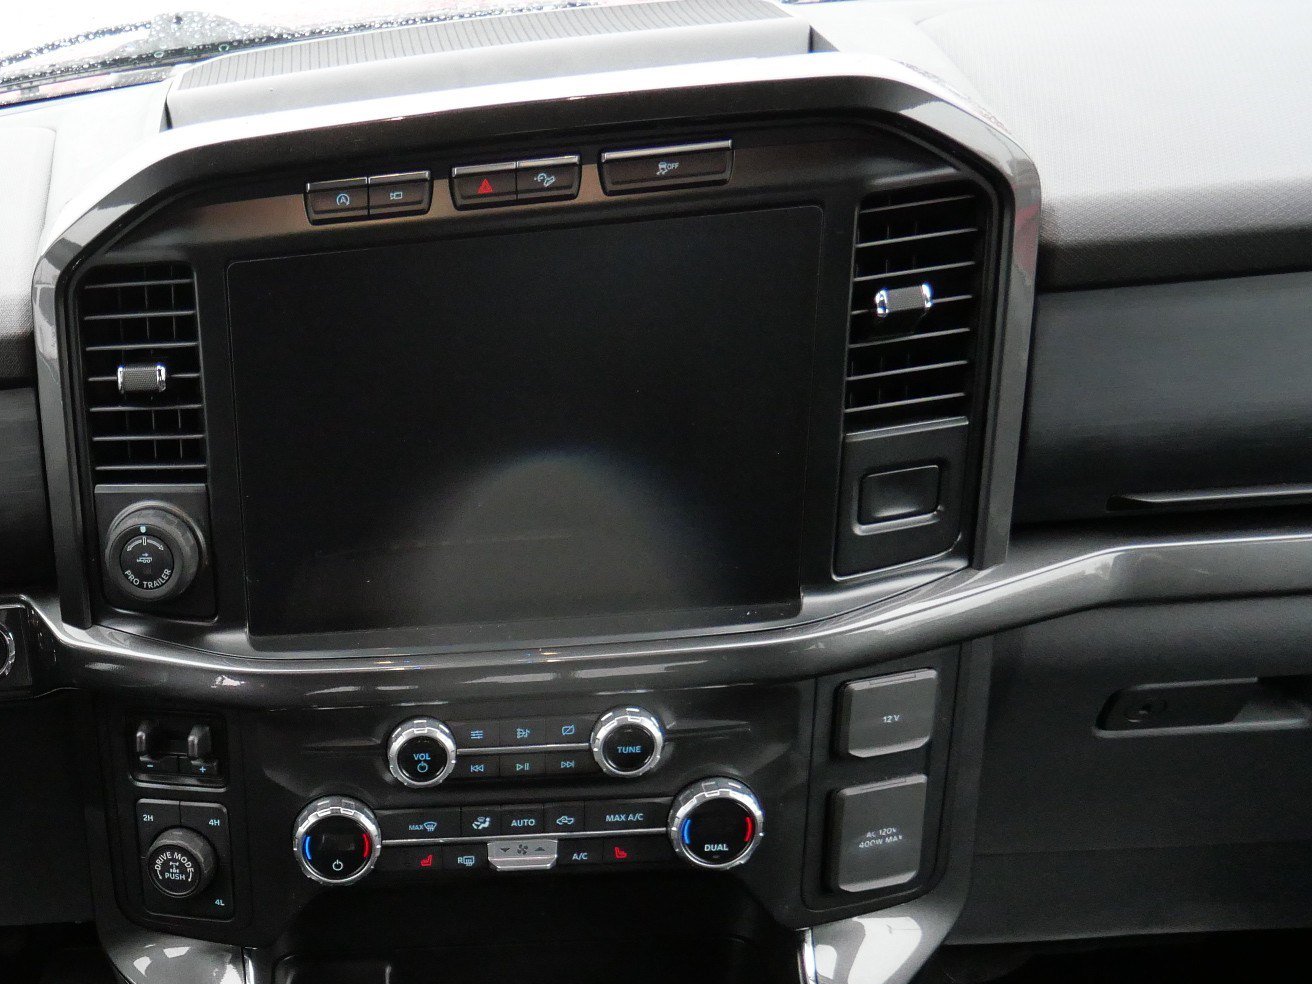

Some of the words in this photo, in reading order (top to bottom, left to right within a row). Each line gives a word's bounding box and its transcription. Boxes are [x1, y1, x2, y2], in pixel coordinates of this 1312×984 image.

[667, 162, 679, 170] OFF
[124, 570, 139, 585] PRO
[143, 569, 171, 588] TRAILER
[617, 746, 641, 754] TUNE
[605, 813, 625, 823] MAX
[627, 812, 643, 822] A/C
[408, 823, 424, 831] MAX
[511, 818, 535, 827] AUTO
[703, 843, 729, 852] DUAL
[572, 851, 588, 861] A/C
[154, 851, 172, 871] DRIVE
[173, 852, 194, 873] MODE
